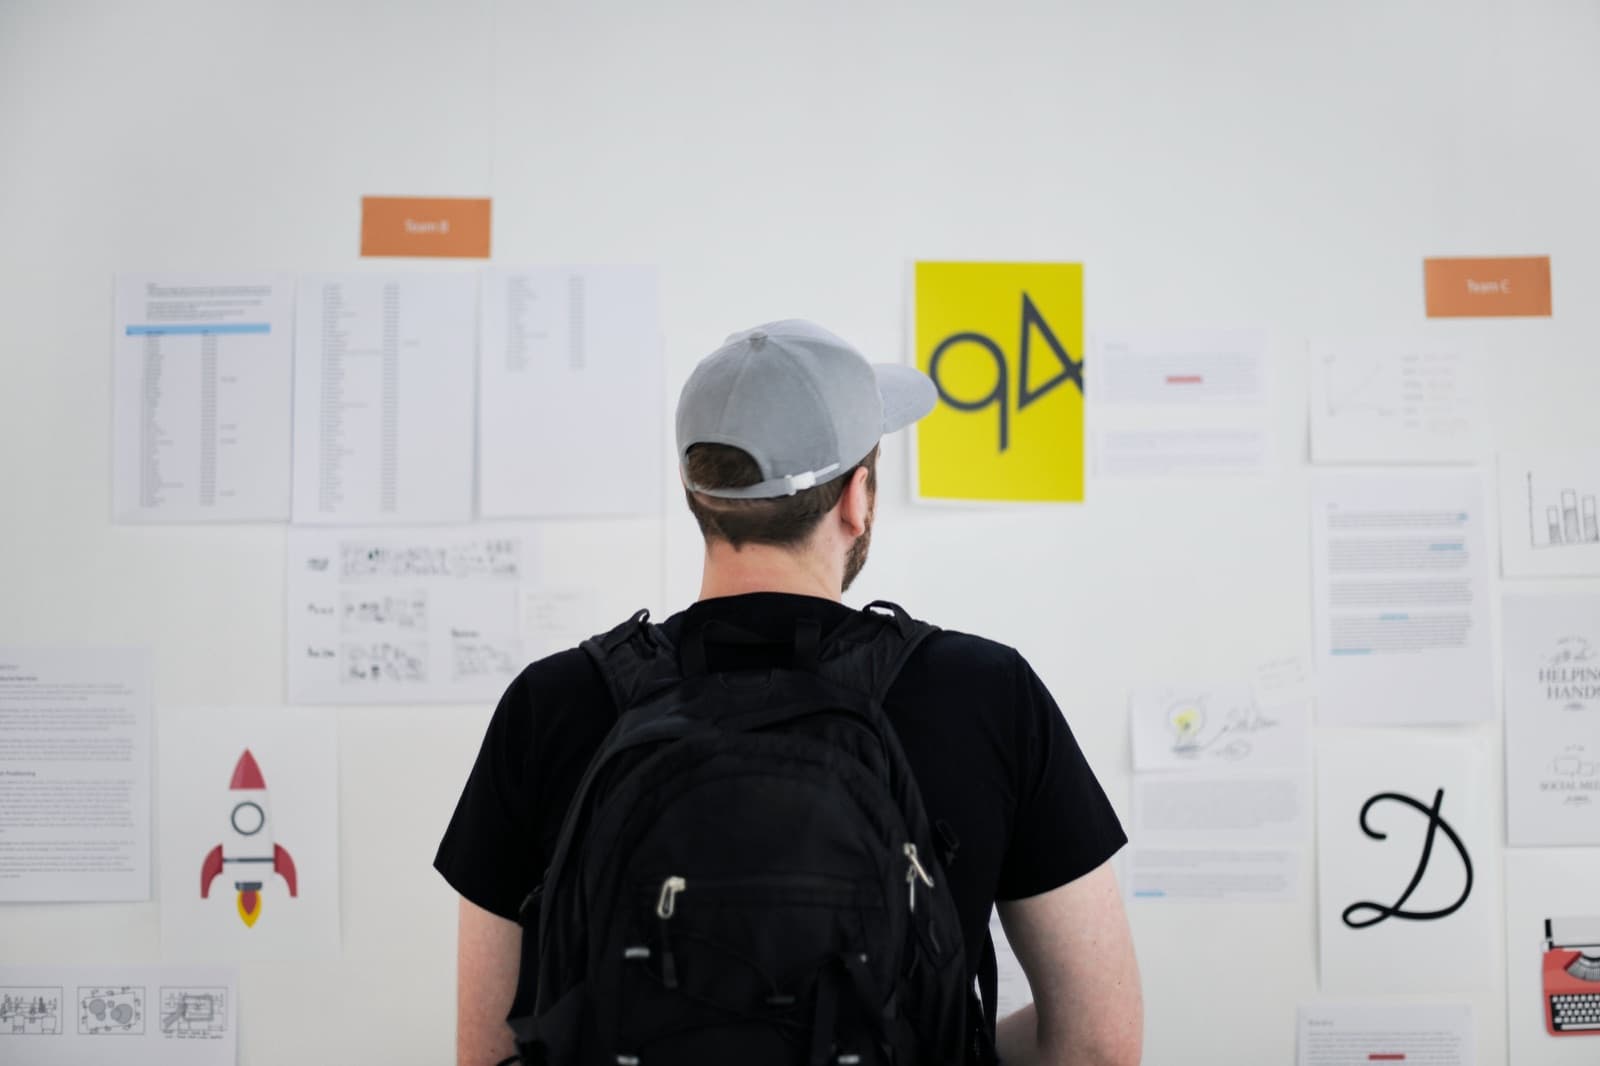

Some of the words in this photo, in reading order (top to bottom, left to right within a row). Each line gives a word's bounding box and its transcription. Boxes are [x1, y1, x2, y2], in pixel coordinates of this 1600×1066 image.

[404, 218, 438, 233] Team
[1466, 278, 1499, 294] Team
[1500, 278, 1512, 294] C
[1538, 667, 1600, 683] HELPIN
[1342, 787, 1473, 928] D
